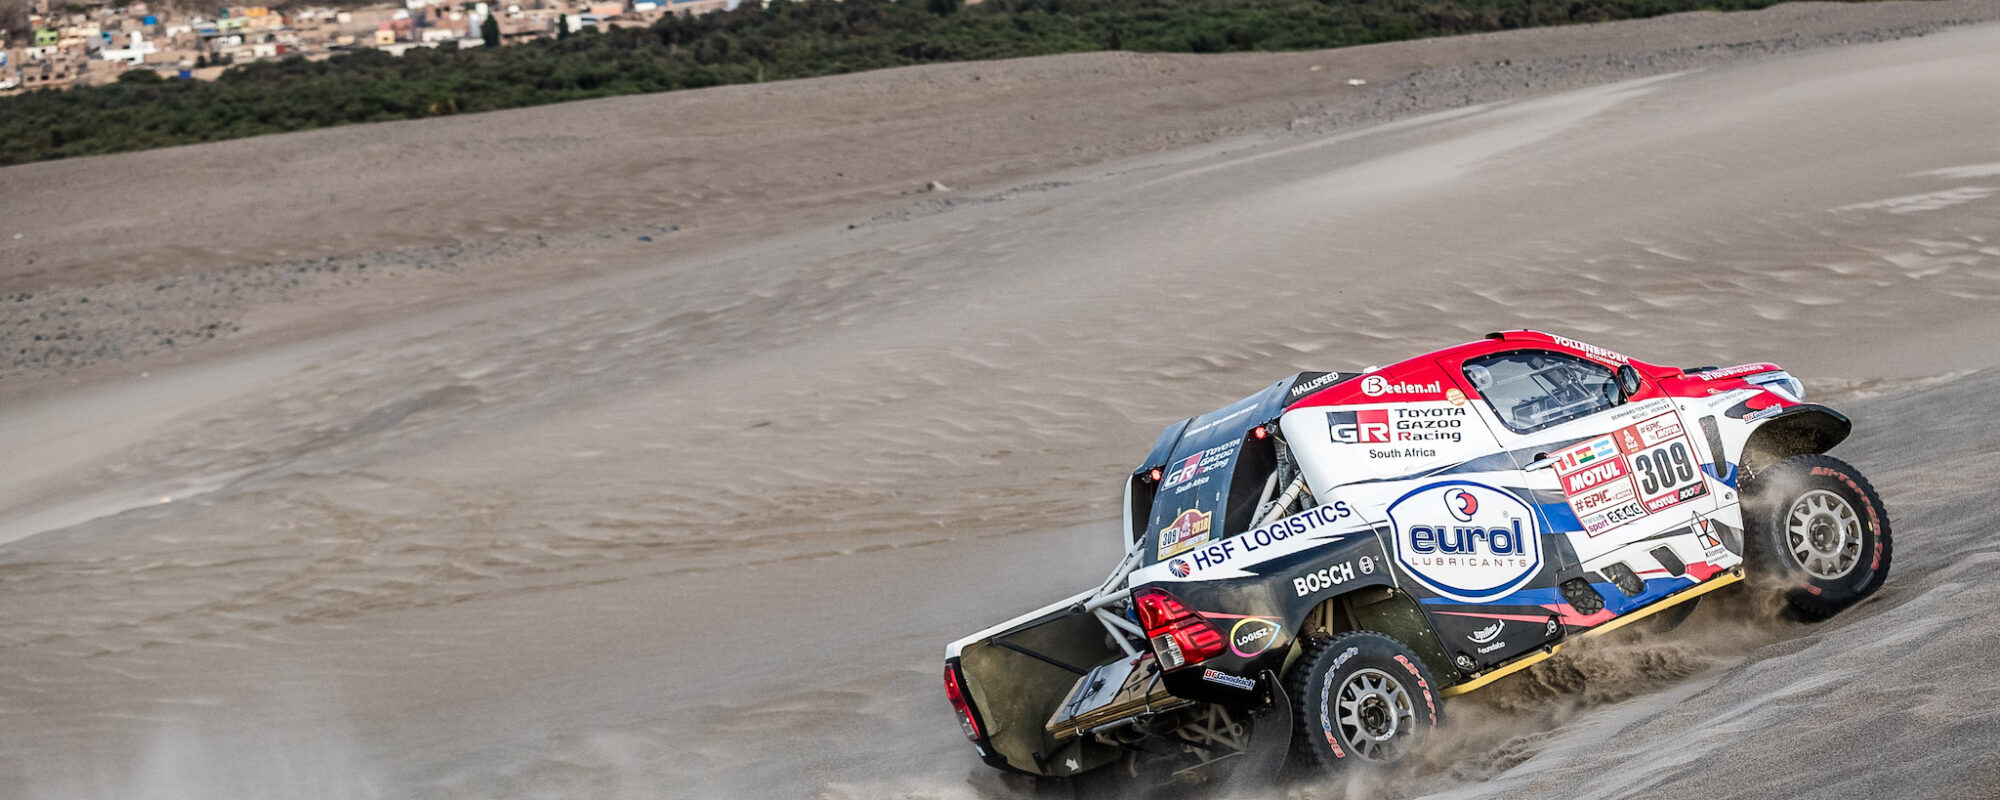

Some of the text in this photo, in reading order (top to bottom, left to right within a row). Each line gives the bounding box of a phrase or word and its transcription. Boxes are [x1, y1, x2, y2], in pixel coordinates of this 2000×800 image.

[1552, 335, 1629, 363] VOLLENBROEK
[1291, 371, 1339, 397] HALLSPEED
[1366, 377, 1441, 394] Beelen.nl
[1394, 407, 1466, 418] TOYOTA
[1331, 422, 1389, 442] GR
[1396, 419, 1461, 430] GAZOO
[1398, 430, 1461, 443] Racing
[1199, 448, 1234, 467] GAZOO
[1205, 438, 1241, 457] TOYOTA
[1369, 447, 1436, 459] South Africa
[1164, 463, 1198, 488] GR
[1196, 458, 1230, 475] Racing
[1569, 461, 1621, 492] MOTUL
[1636, 442, 1694, 495] 309
[1575, 489, 1612, 512] #EPIC
[1648, 494, 1678, 510] MOTUL
[1162, 529, 1177, 546] 309
[1191, 517, 1209, 535] 2018
[1193, 541, 1234, 571] HSF
[1240, 500, 1351, 552] LOGISTICS
[1589, 519, 1609, 533] sport
[1409, 517, 1526, 556] eurol
[1411, 557, 1527, 567] LUBRICANTS
[1293, 561, 1355, 597] BOSCH
[1236, 627, 1268, 647] LOGISZ
[1204, 669, 1256, 690] BFGoodrich
[1321, 647, 1358, 758] BFGoodrich
